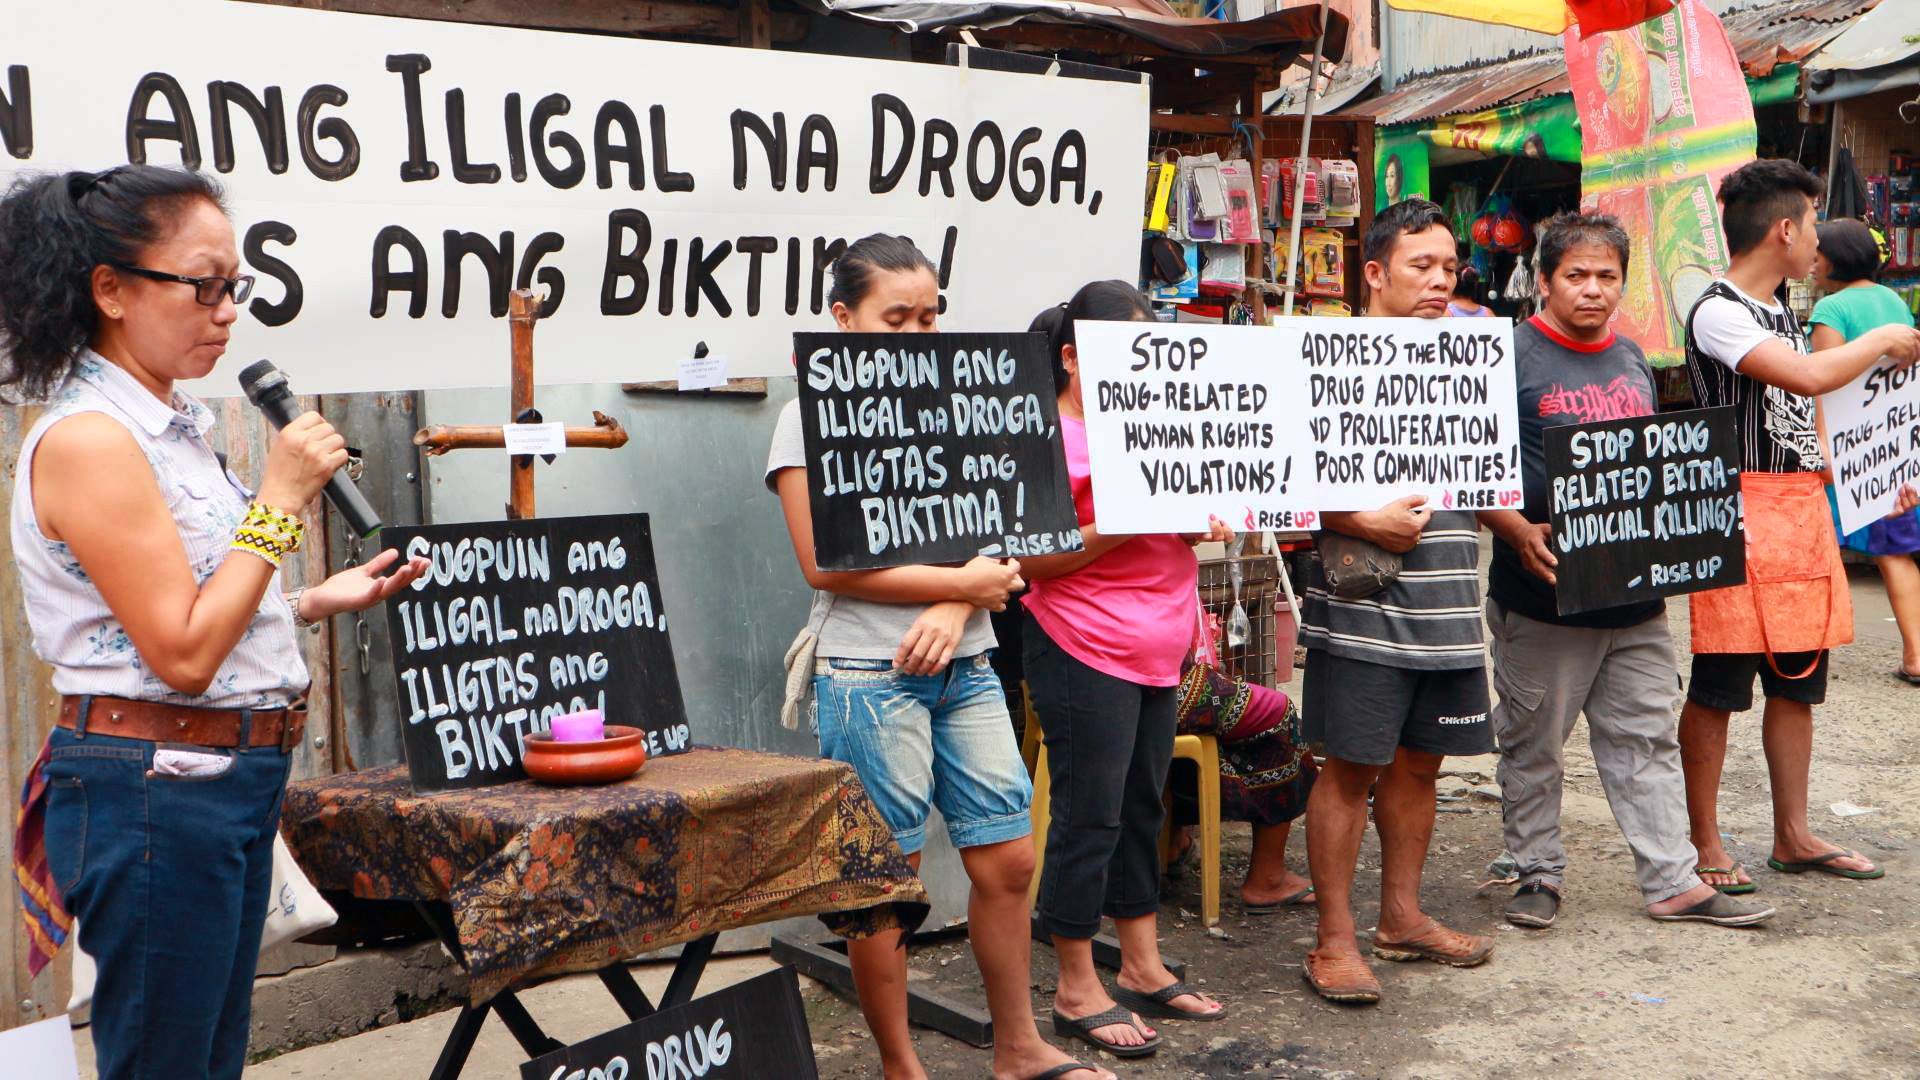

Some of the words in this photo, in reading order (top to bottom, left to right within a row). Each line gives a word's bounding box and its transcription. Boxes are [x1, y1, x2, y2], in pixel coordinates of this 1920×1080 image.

[126, 71, 360, 182] ANG
[385, 53, 695, 193] ILIGAL
[730, 108, 838, 192] NA
[869, 93, 1102, 216] DROGA,
[370, 225, 565, 319] ANG
[807, 346, 940, 392] SUGPUIN
[953, 347, 1016, 389] ANG
[1131, 332, 1208, 371] STOP
[1301, 331, 1398, 367] ADDRESS
[1403, 342, 1436, 365] THE
[1438, 331, 1505, 368] ROOTS
[1098, 380, 1268, 414] DRUG-RELATED
[1310, 373, 1365, 408] DRUG
[1374, 373, 1488, 408] ADDICTION
[817, 397, 915, 440] ILIGAL
[951, 393, 1055, 440] DROGA,
[1124, 421, 1195, 454] HUMAN
[1201, 420, 1274, 450] RIGHTS
[1309, 416, 1331, 444] ND
[1339, 411, 1499, 447] PROLIFERATION
[1832, 398, 1920, 459] DRUG-REL
[1315, 450, 1365, 484] POOR
[1373, 443, 1518, 485] COMMUNITIES!
[1570, 430, 1635, 469] STOP
[1643, 419, 1709, 458] DRUG
[1840, 435, 1900, 487] HUMAN
[821, 445, 948, 497] ILIGTAS
[1140, 455, 1292, 496] VIOLATIONS!
[1553, 465, 1652, 514] RELATED
[1662, 455, 1738, 496] EXTRA-
[1258, 510, 1293, 528] RISE
[1294, 510, 1316, 529] UP
[1457, 489, 1496, 508] RISE
[1498, 489, 1522, 507] UP
[1004, 533, 1054, 556] RISE
[1058, 528, 1084, 551] UP
[1557, 506, 1651, 553] JUDICIAL
[1653, 491, 1744, 542] KILLINGS!
[407, 535, 550, 591] SUGPUIN
[1651, 562, 1692, 587] RISE
[1696, 555, 1723, 579] UP
[399, 594, 518, 653] ILIGAL
[558, 581, 667, 635] DROGA,
[401, 652, 539, 724] ILIGTAS
[663, 724, 689, 751] UP
[1438, 712, 1487, 724] CHRISTIE
[645, 1017, 732, 1080] DRUG
